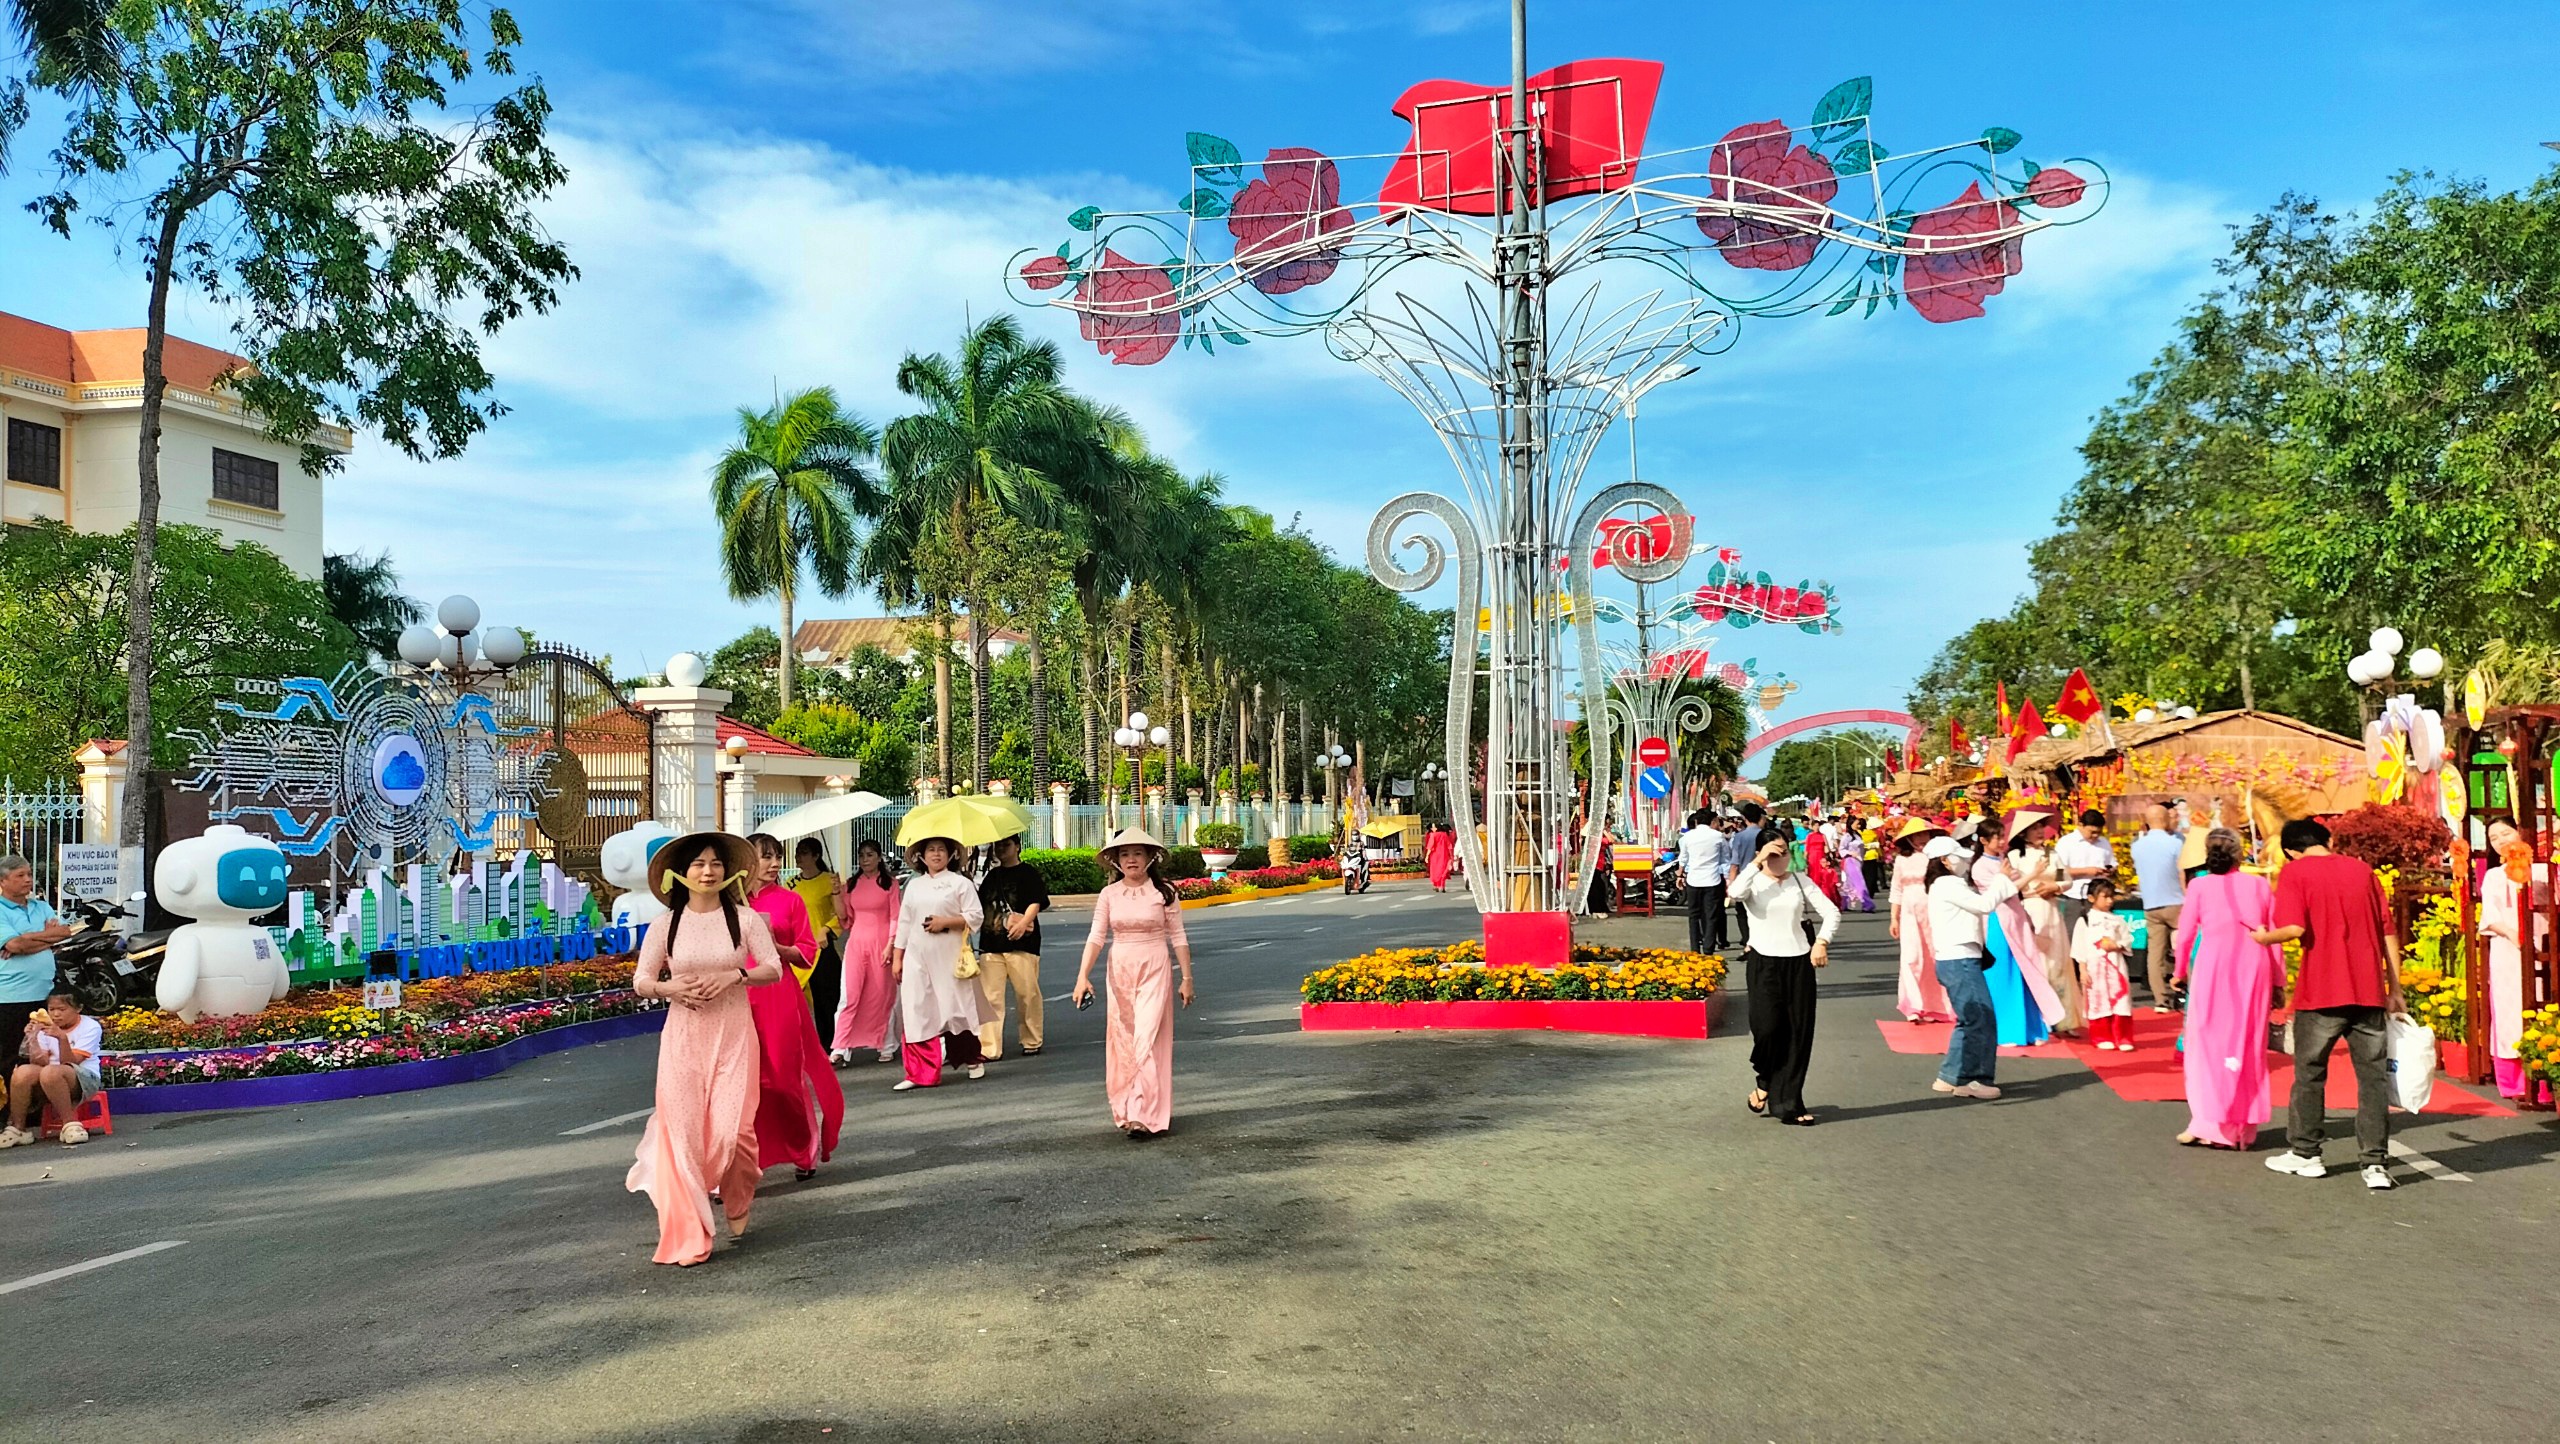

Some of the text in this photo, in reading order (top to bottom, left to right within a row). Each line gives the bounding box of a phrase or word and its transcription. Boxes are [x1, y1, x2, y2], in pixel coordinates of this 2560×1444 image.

[67, 851, 80, 860] KHU
[102, 877, 117, 885] AREA
[602, 912, 630, 954] SỐ
